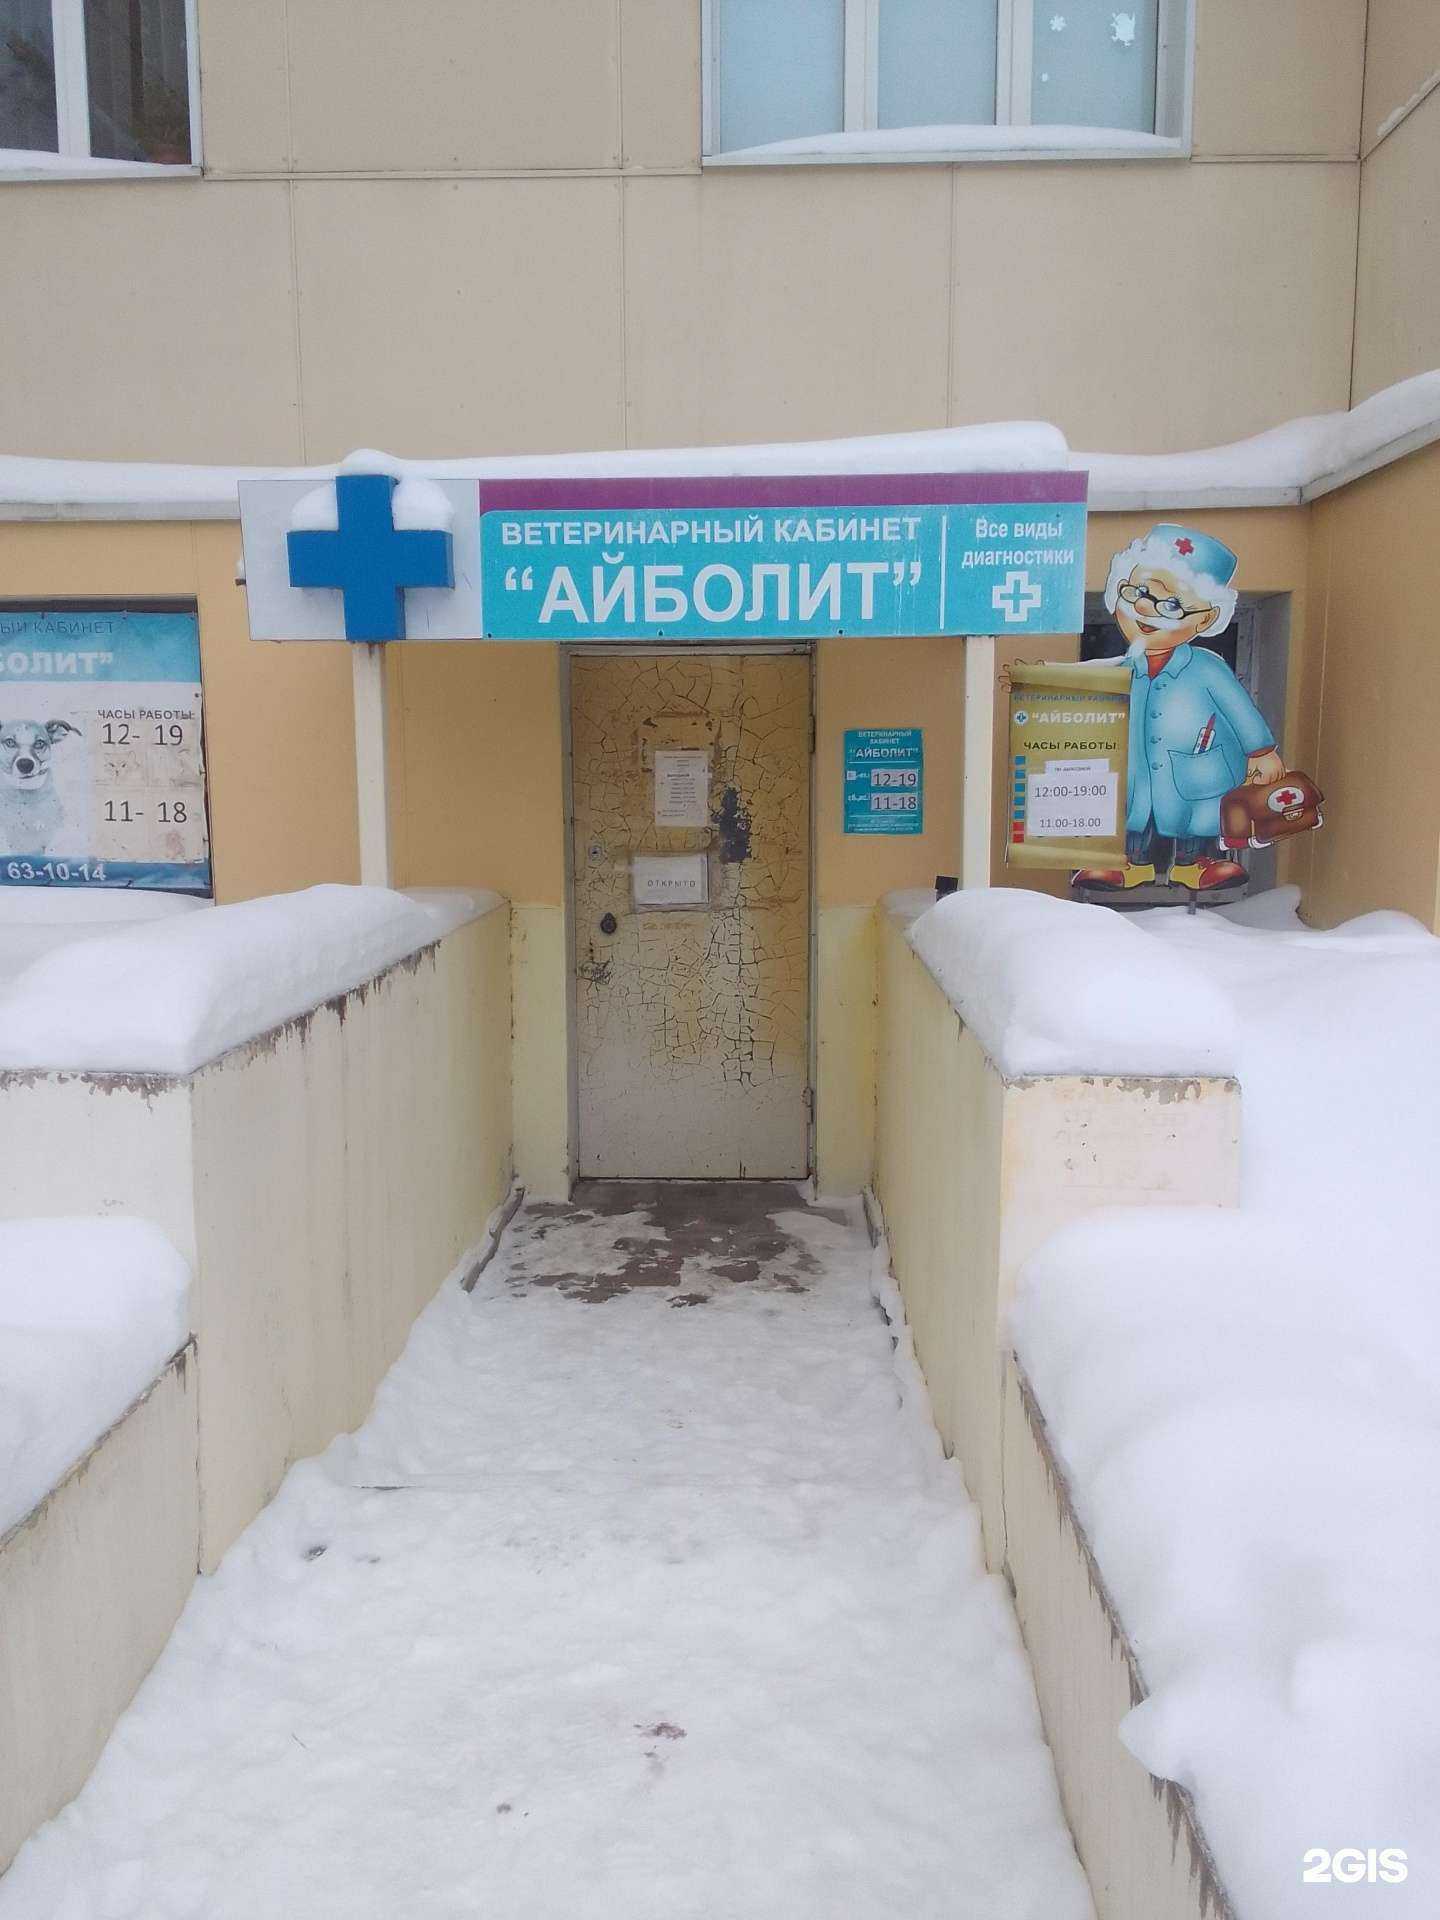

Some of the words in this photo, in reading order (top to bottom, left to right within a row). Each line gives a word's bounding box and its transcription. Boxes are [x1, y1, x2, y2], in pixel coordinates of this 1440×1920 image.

[502, 515, 763, 545] ВЕТЕРИНАРНЫЙ
[775, 517, 921, 542] КАБИНЕТ
[975, 519, 1008, 538] Все
[1014, 521, 1062, 539] виды
[961, 549, 1073, 568] диагностики
[34, 621, 113, 633] КАБИНЕТ
[0, 652, 113, 674] ОЛИТ”
[97, 710, 135, 719] ЧАСЫ
[154, 725, 183, 746] 19
[1024, 742, 1060, 750] ЧАСЫ
[873, 773, 916, 785] 12-19
[1034, 785, 1107, 798] 12:00-19:00
[157, 802, 187, 823] 18
[874, 797, 916, 809] 11-18
[7, 862, 106, 881] 63-10-14
